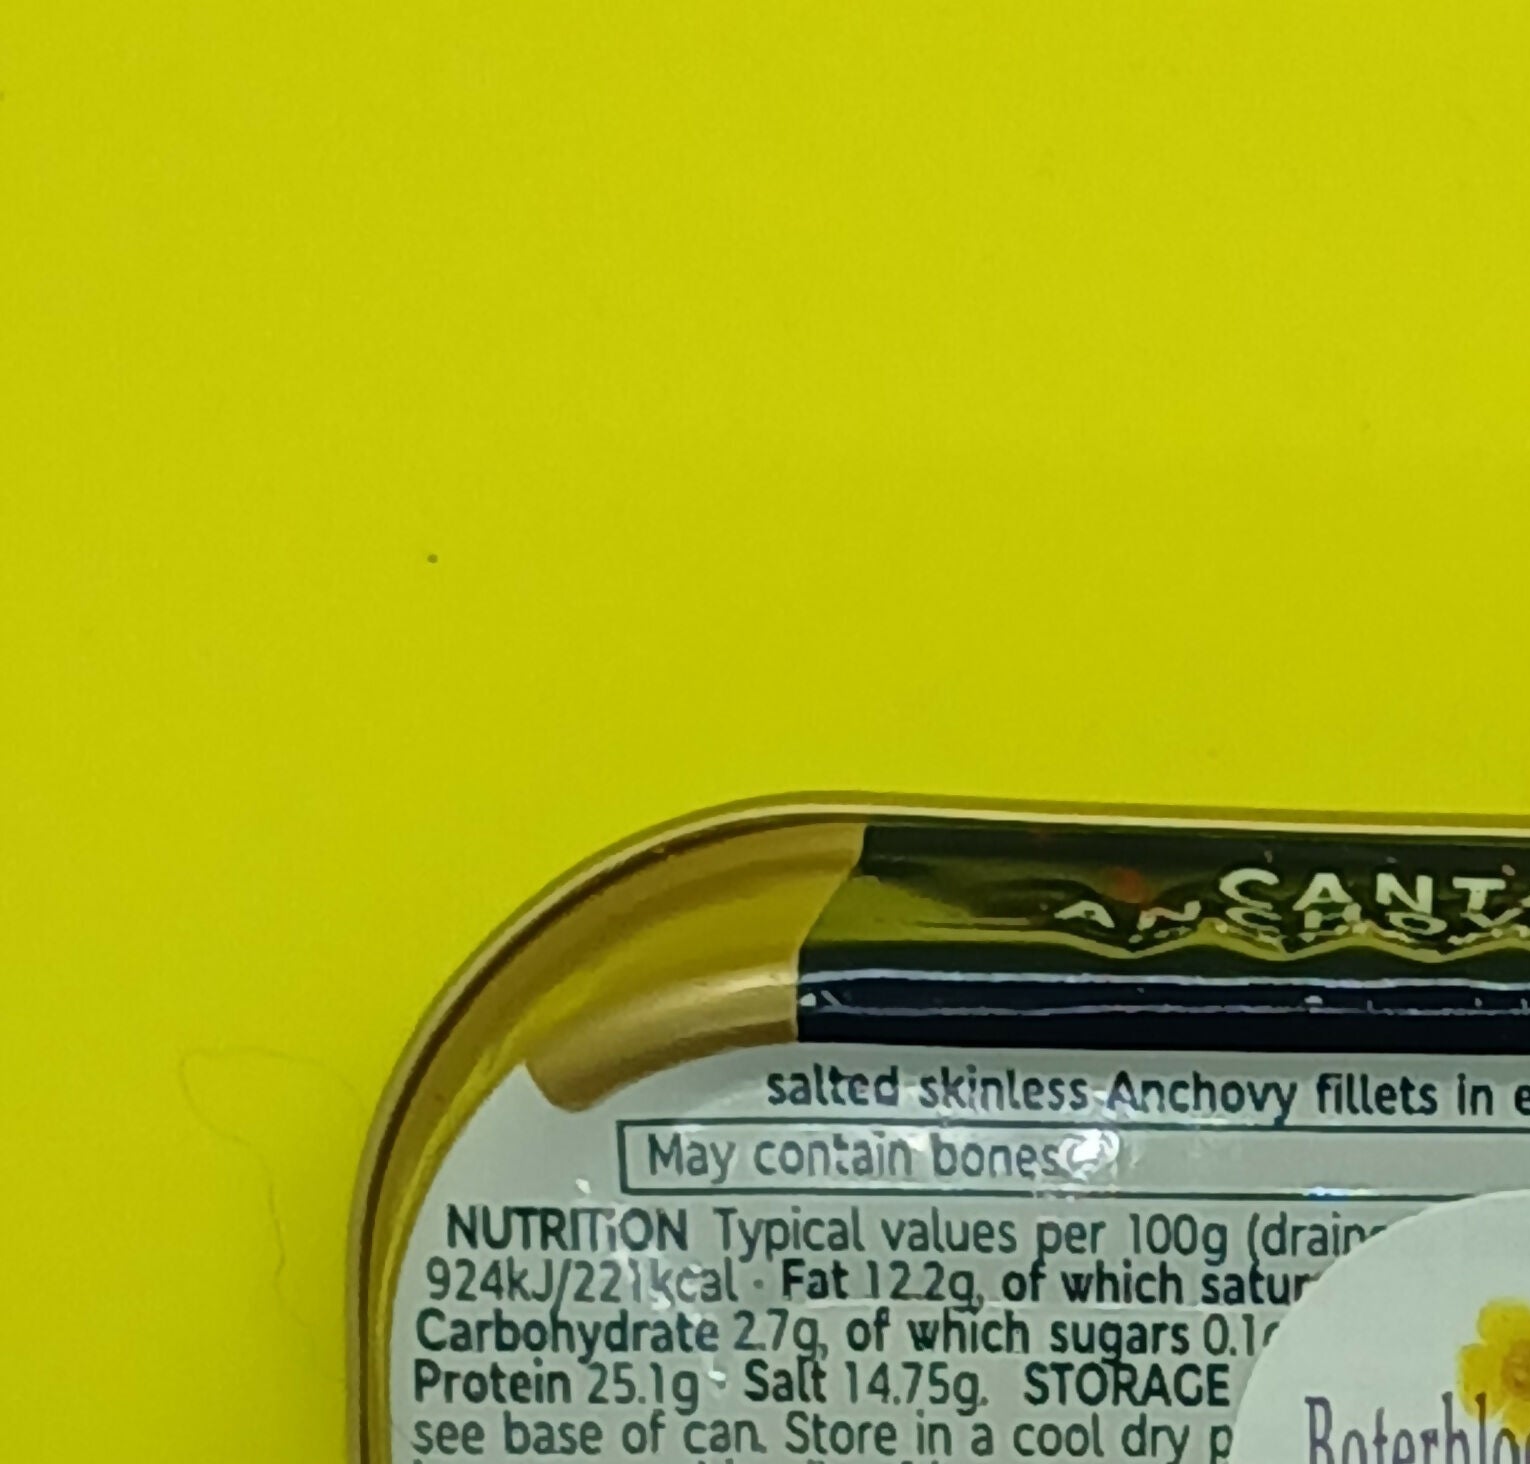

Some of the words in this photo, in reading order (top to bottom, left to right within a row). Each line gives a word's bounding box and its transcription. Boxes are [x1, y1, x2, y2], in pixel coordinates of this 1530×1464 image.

[767, 1063, 899, 1106] salted
[919, 1065, 1088, 1112] skinless
[1107, 1070, 1297, 1126] Anchovy
[1316, 1072, 1438, 1115] fillets
[1458, 1075, 1494, 1115] in
[648, 1132, 735, 1184] May
[753, 1131, 912, 1177] contain
[930, 1133, 1060, 1178] bones
[448, 1204, 688, 1252] NUTRITION
[714, 1206, 866, 1263] Typical
[882, 1207, 1017, 1254] values
[1036, 1219, 1106, 1264] per
[1130, 1213, 1228, 1266] 100g
[427, 1257, 738, 1314] 924kJ/221kcal
[783, 1258, 848, 1299] Fat
[1002, 1261, 1046, 1301] of
[1061, 1260, 1184, 1304] which
[1201, 1264, 1323, 1306] satur
[416, 1308, 719, 1363] Carbohydrate
[846, 1307, 889, 1351] of
[908, 1308, 1030, 1353] which
[1050, 1320, 1189, 1360] sugars
[413, 1358, 571, 1404] Protein
[588, 1361, 699, 1415] 25.1g
[744, 1354, 826, 1403] Salt
[846, 1361, 988, 1416] 14.75g.
[1023, 1361, 1230, 1406] STORAGE
[411, 1421, 485, 1455] see
[504, 1411, 603, 1455] base
[622, 1411, 665, 1454] of
[785, 1411, 897, 1455] Store
[917, 1409, 952, 1456] in
[971, 1422, 994, 1457] a
[1013, 1413, 1103, 1458] cool
